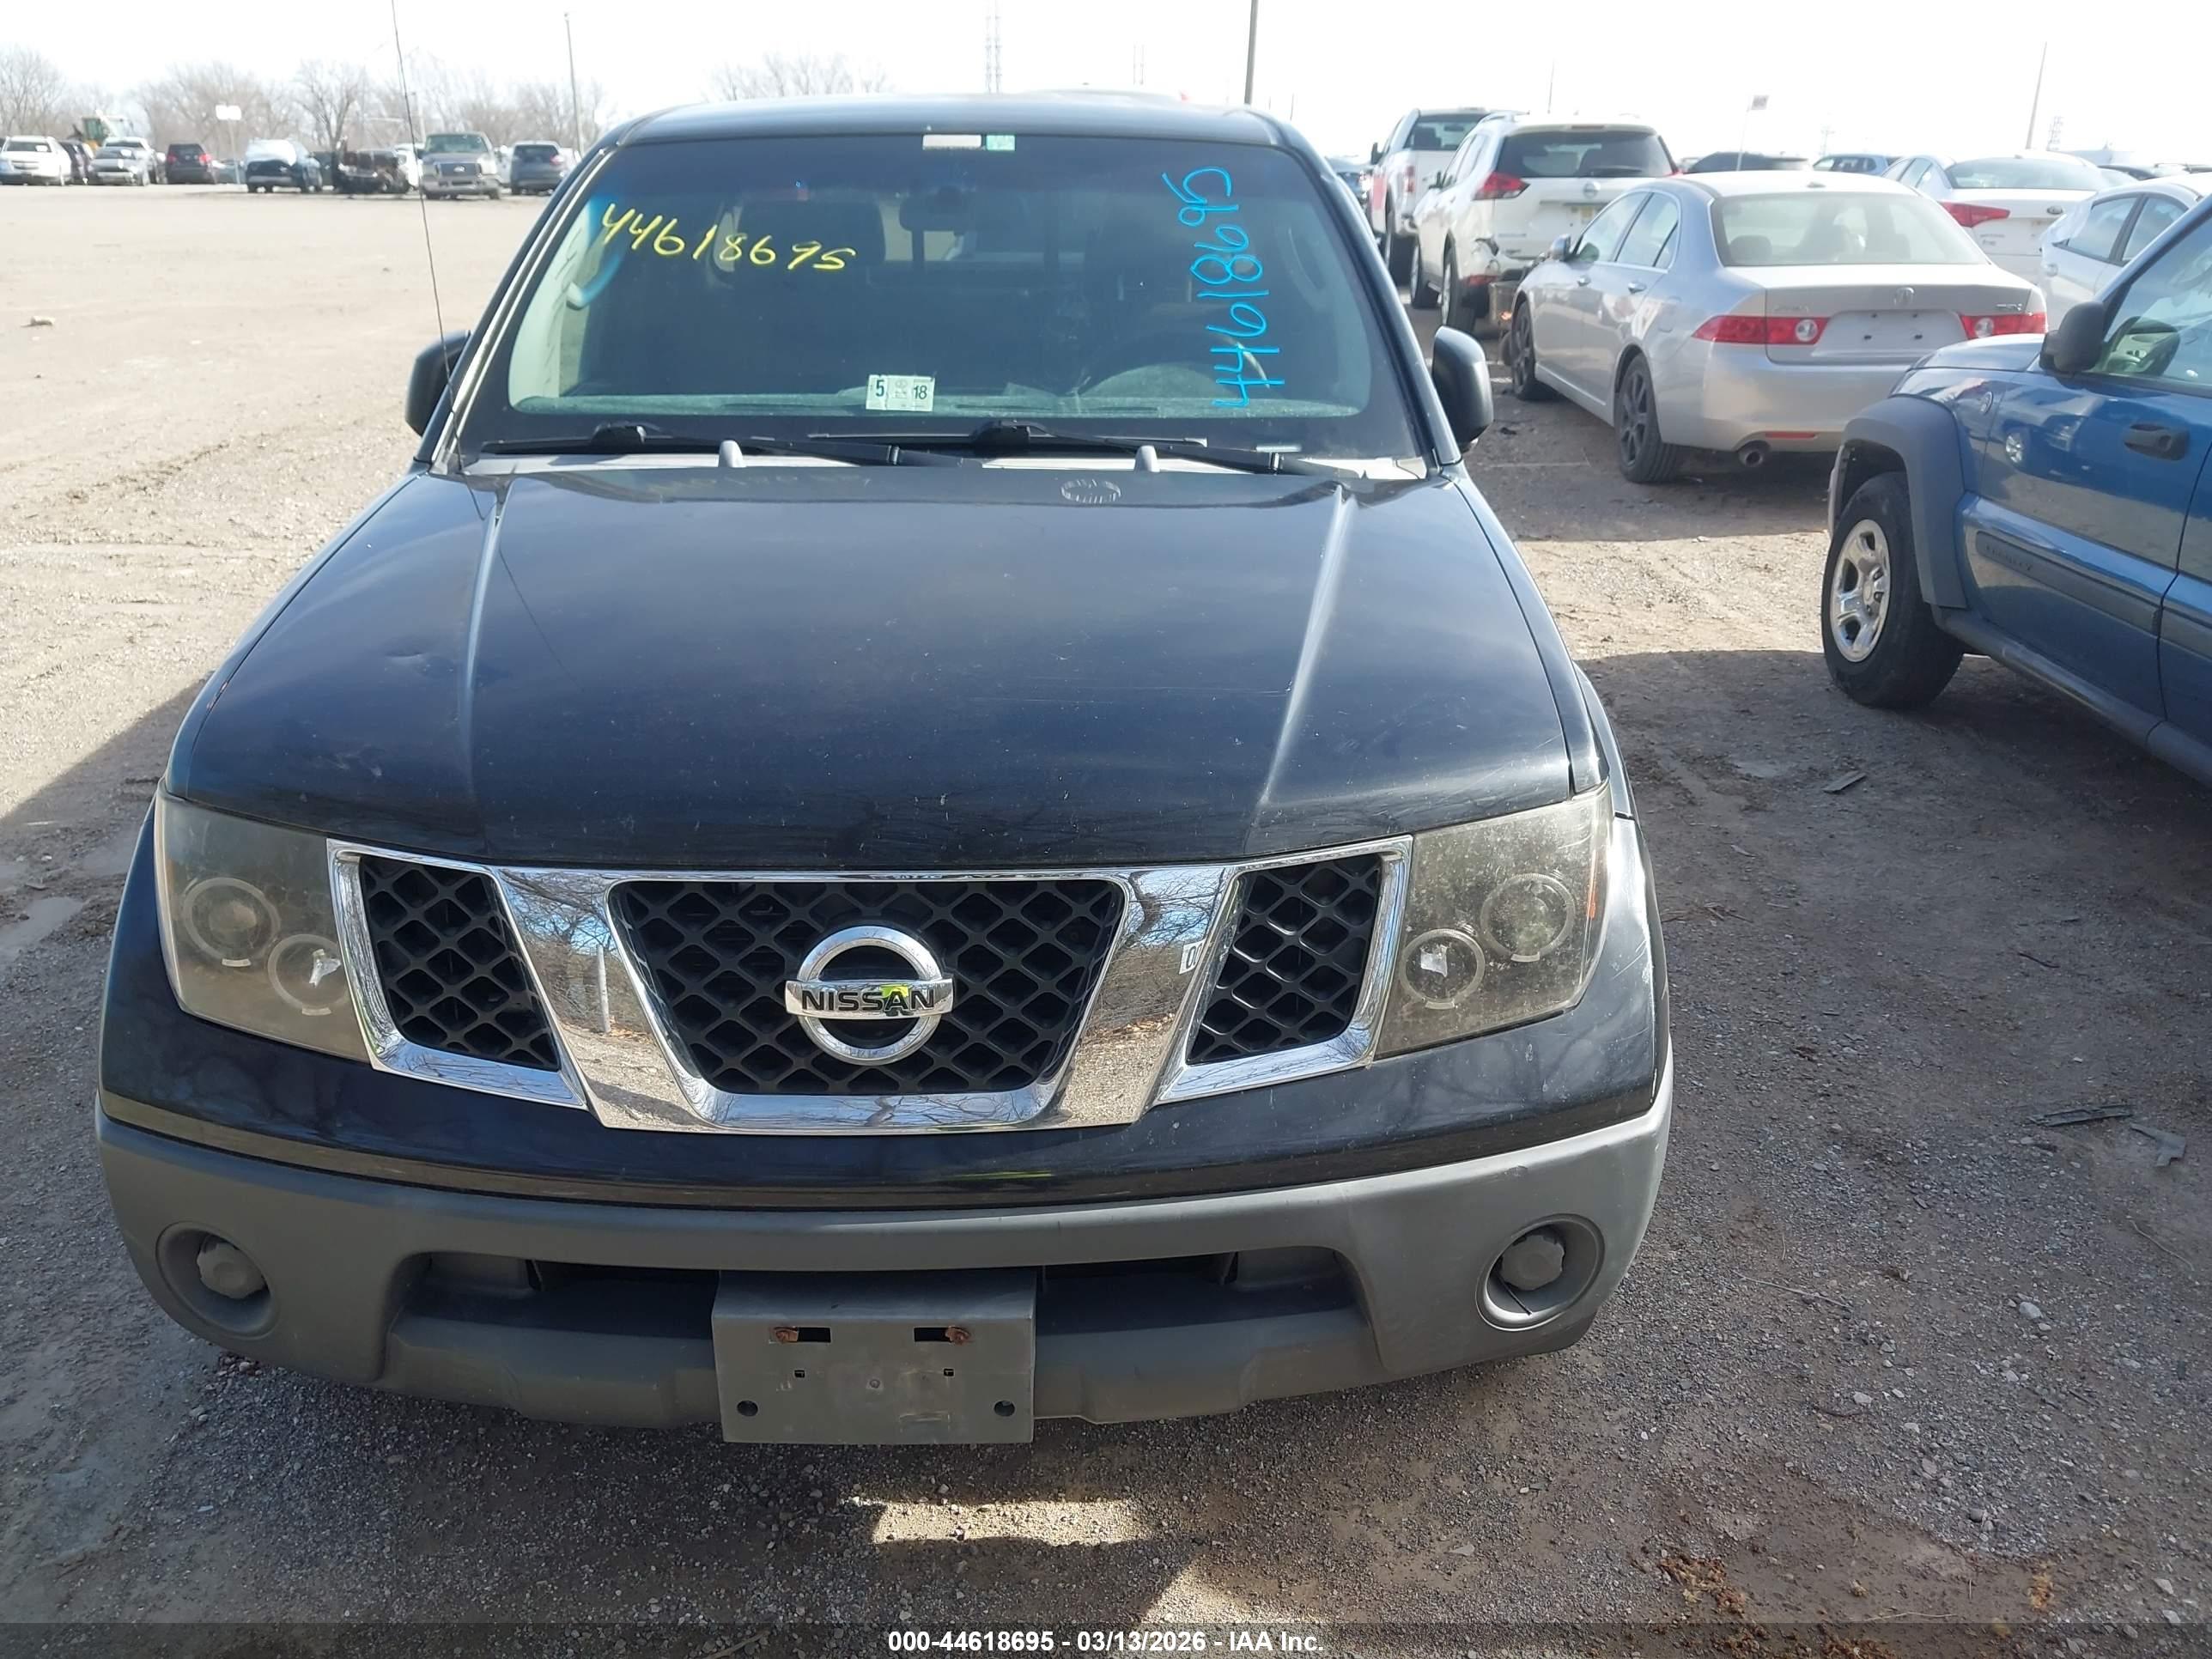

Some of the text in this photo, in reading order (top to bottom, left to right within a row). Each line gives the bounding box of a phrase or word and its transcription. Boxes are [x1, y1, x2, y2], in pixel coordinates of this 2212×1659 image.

[602, 203, 856, 270] 44618695
[1160, 166, 1286, 409] 44618695
[876, 380, 928, 400] 5 18
[802, 989, 934, 1011] NISSAN
